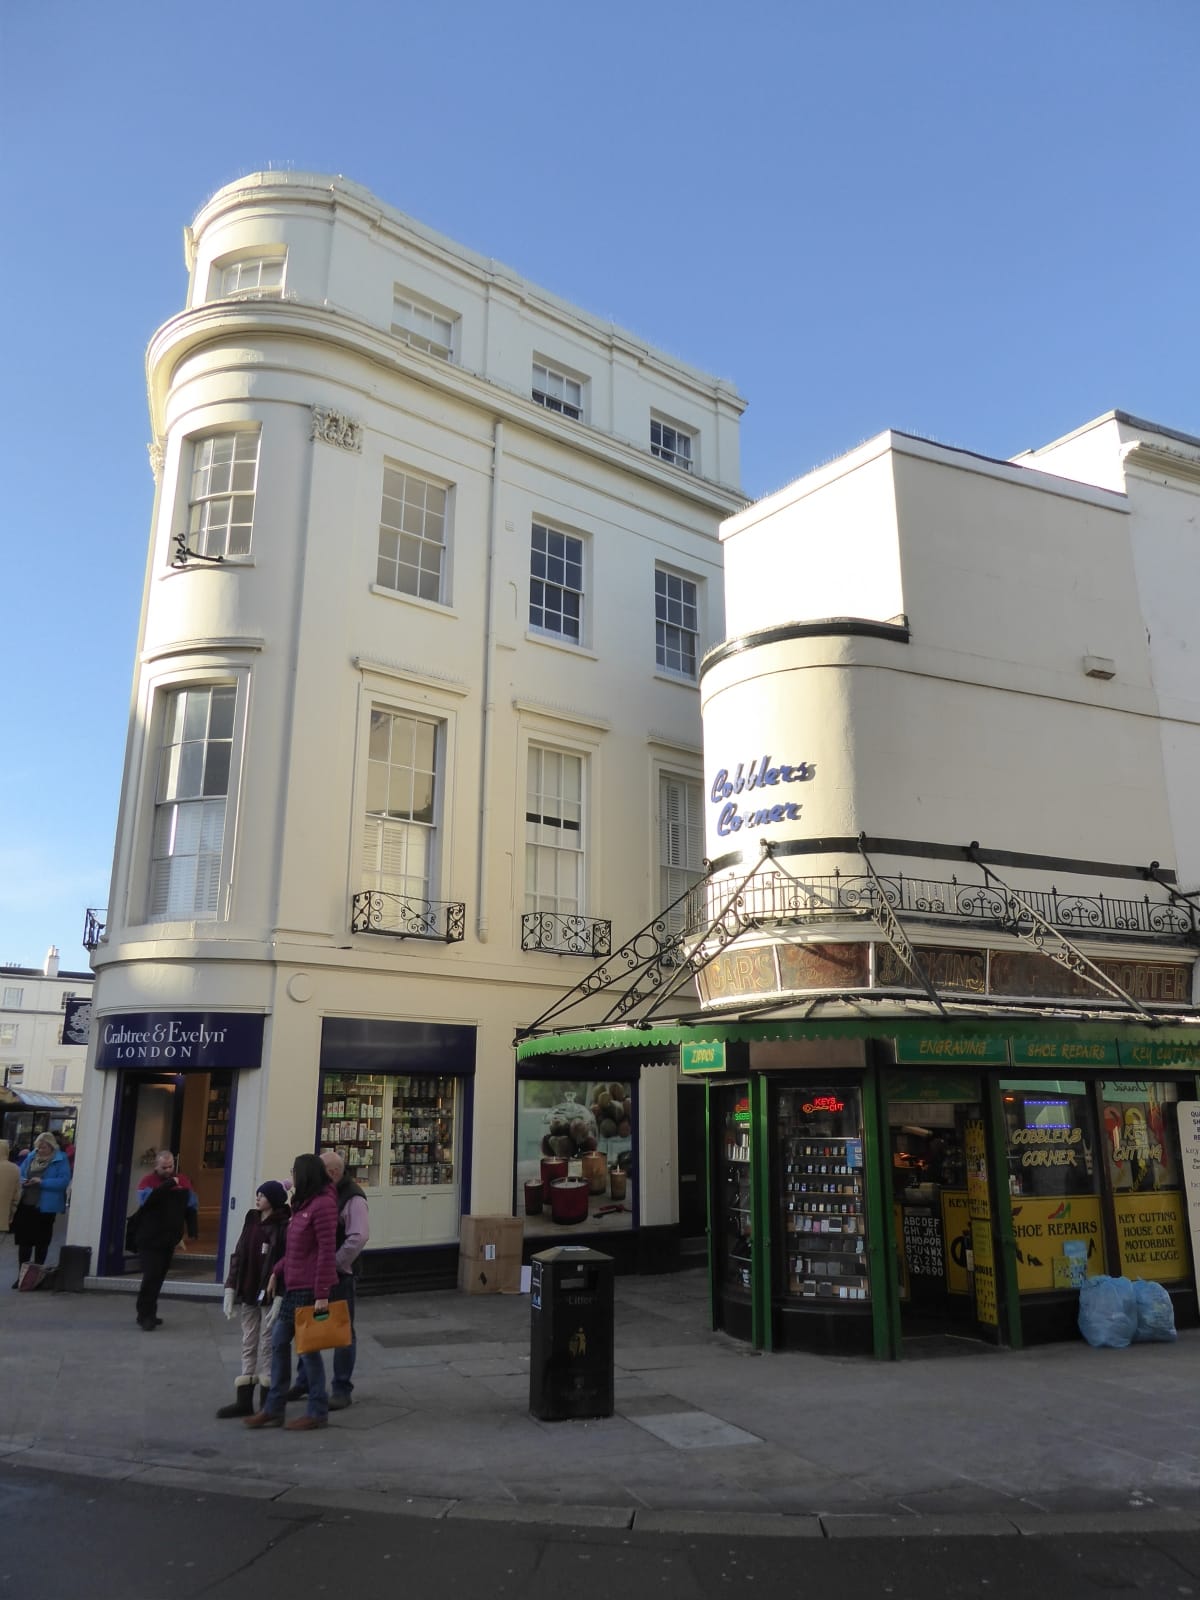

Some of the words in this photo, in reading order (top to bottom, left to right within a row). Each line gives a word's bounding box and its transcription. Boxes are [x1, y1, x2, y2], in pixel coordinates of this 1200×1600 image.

[711, 755, 814, 803] Cobblers
[717, 802, 802, 836] Corner
[104, 1023, 150, 1045] Crabtree
[152, 1023, 167, 1043] &
[117, 1046, 192, 1058] LONDON
[919, 1040, 987, 1056] ENGRAVING
[1027, 1043, 1057, 1057] SHOE
[1061, 1044, 1105, 1059] REPAIRS
[814, 1097, 836, 1106] KEYS
[829, 1103, 844, 1112] CUT
[1012, 1128, 1081, 1144] COBBLERS
[1021, 1149, 1077, 1168] CORNER
[1113, 1143, 1162, 1162] CUTTING
[1118, 1213, 1136, 1224] KEY
[1138, 1211, 1176, 1223] CUTTING
[1047, 1221, 1098, 1236] REPAIRS
[1123, 1226, 1152, 1237] HOUSE
[1155, 1224, 1175, 1236] CAR
[1125, 1238, 1177, 1251] MOTORBIKE
[1124, 1252, 1147, 1264] YALE
[1150, 1250, 1180, 1262] LEGGE
